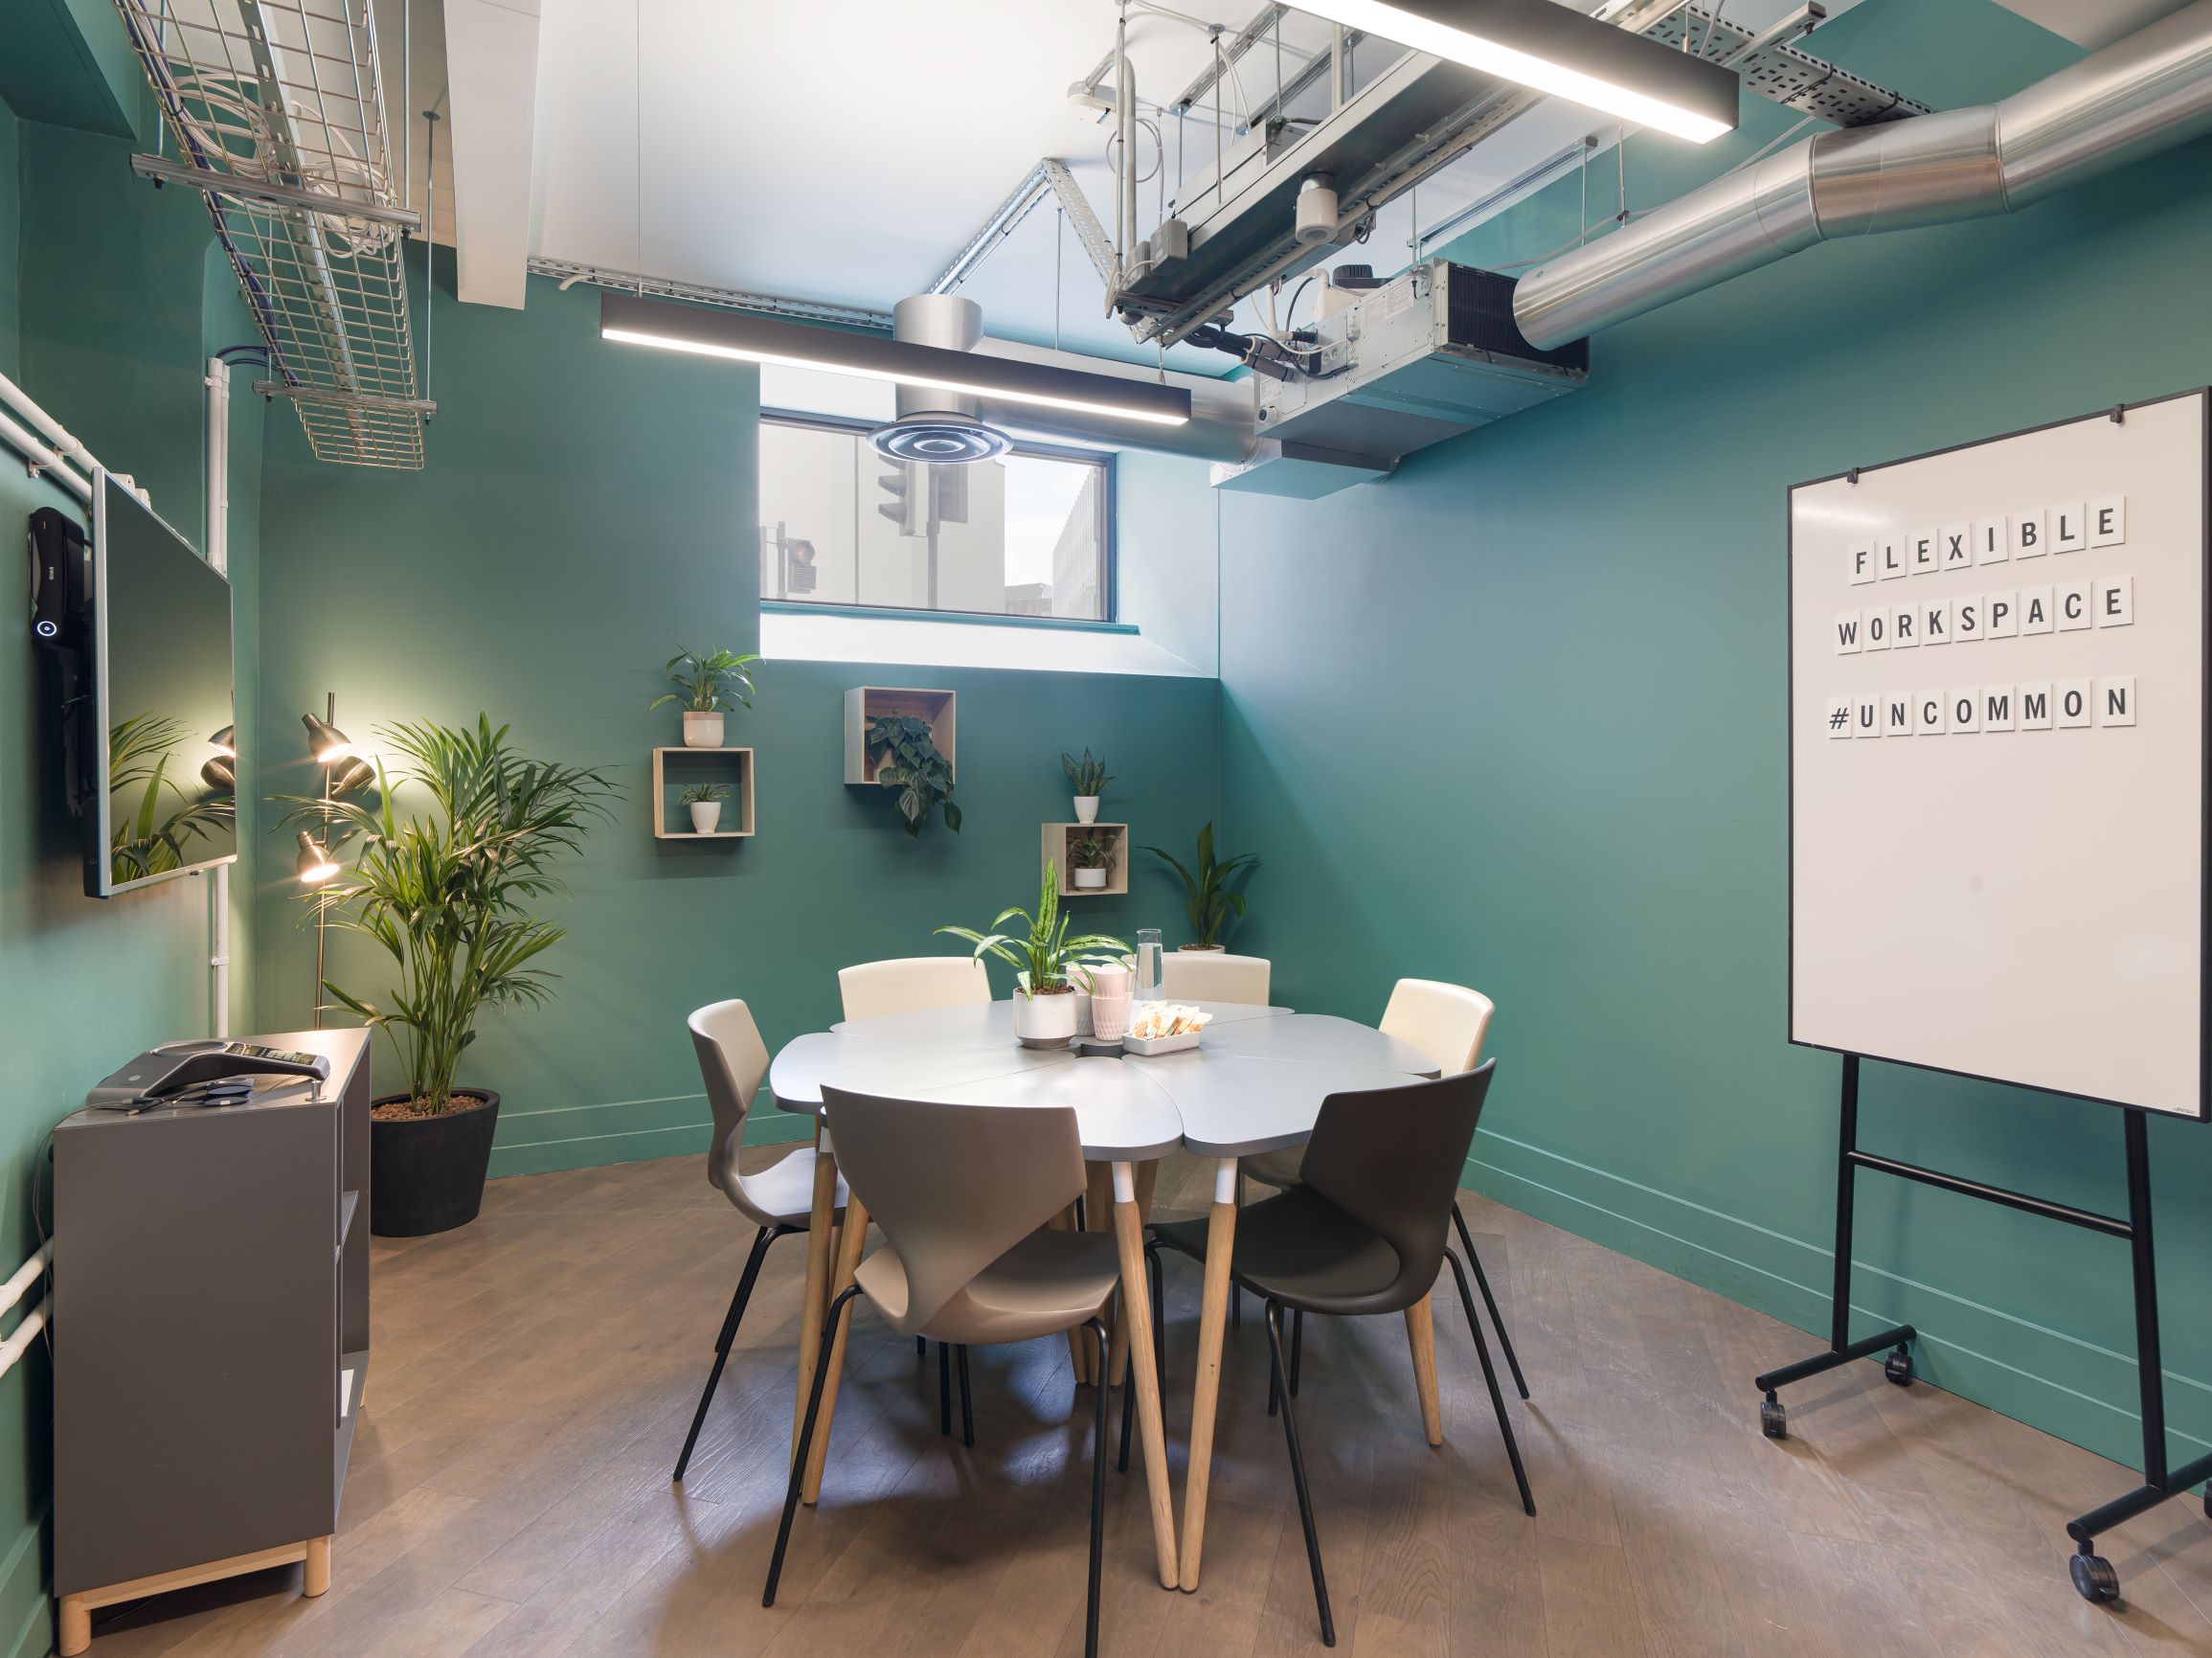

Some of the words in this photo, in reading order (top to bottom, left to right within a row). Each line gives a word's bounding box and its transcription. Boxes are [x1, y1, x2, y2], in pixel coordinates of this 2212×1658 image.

[1856, 508, 2114, 575] FLEXIBLE
[1838, 588, 2122, 646] WORKSPACE
[1829, 688, 2126, 730] #UNCOMMON
